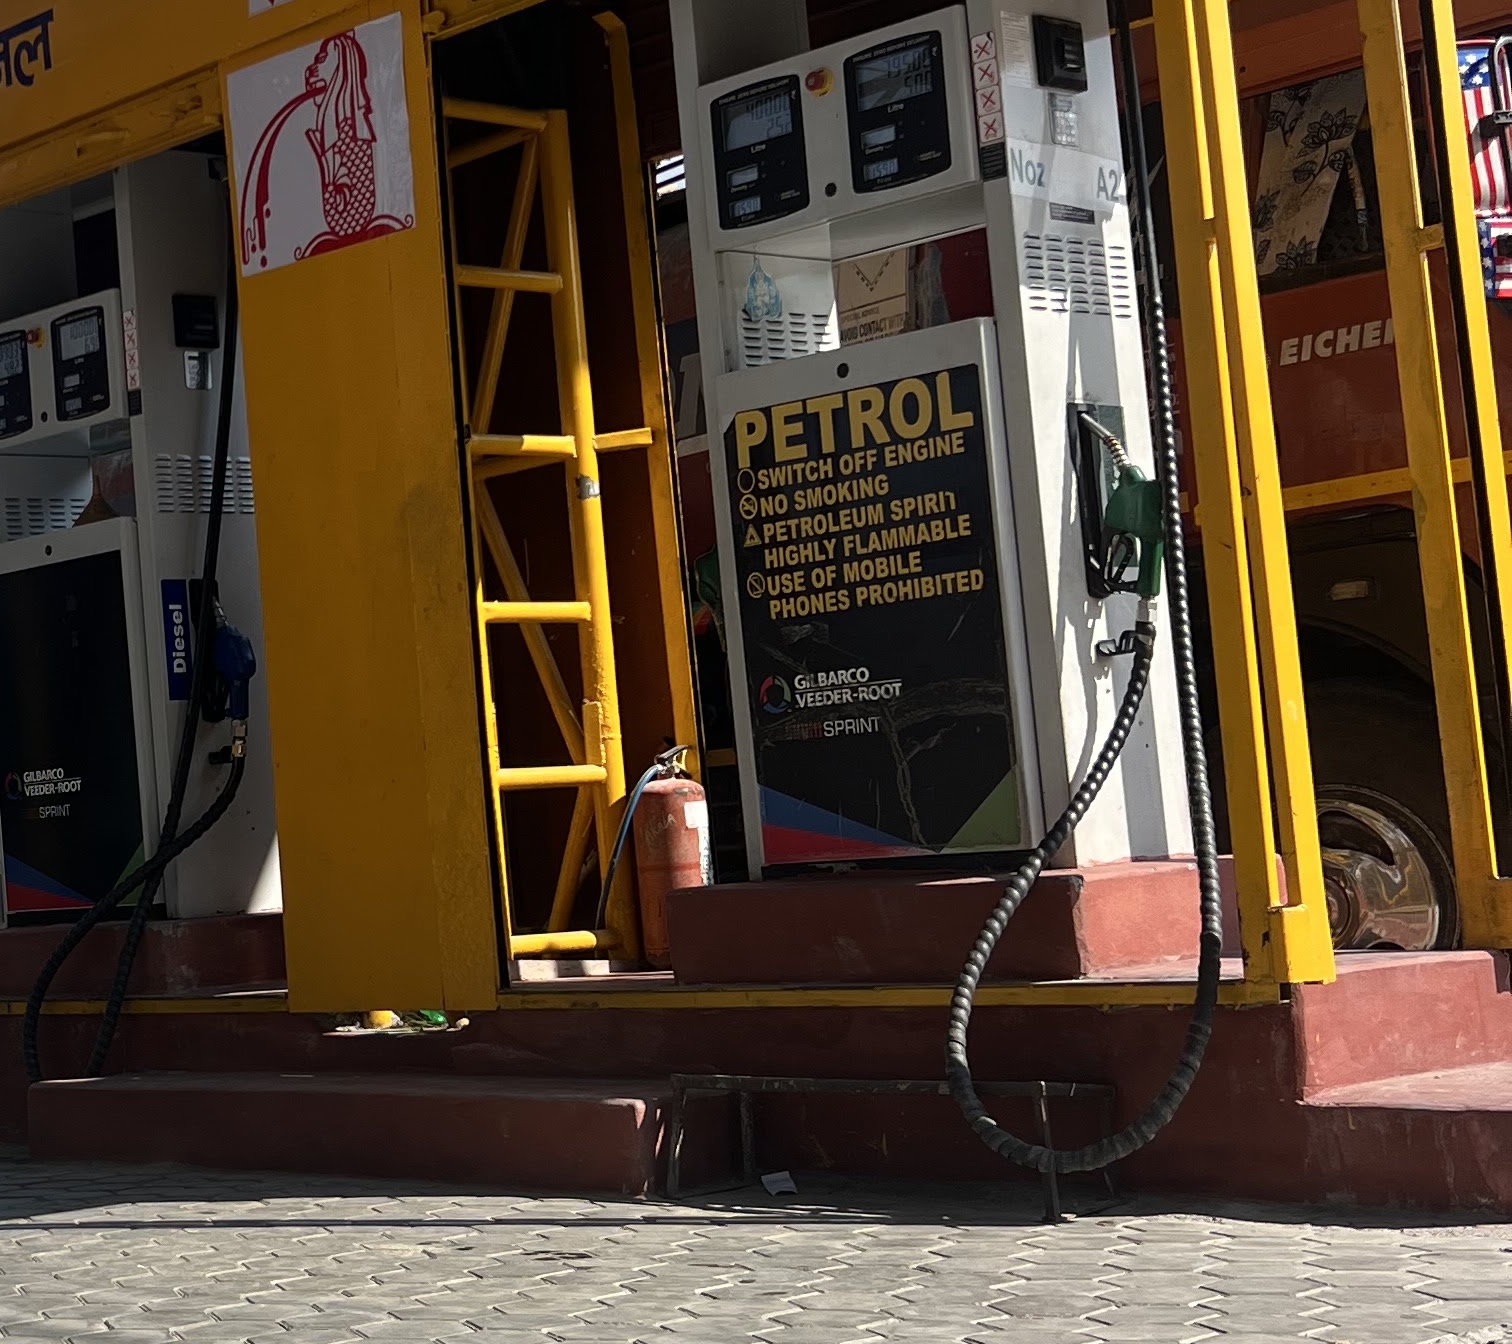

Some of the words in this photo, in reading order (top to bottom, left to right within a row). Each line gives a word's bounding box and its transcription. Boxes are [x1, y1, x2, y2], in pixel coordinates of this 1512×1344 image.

[1097, 167, 1120, 201] A2
[734, 371, 975, 469] PETROL
[757, 457, 834, 490] SWITCH
[839, 449, 878, 476] OFF
[884, 431, 966, 468] ENGINE
[760, 493, 788, 518] NO
[794, 473, 890, 511] SMOKING
[763, 503, 885, 545] PETROLEUM
[890, 491, 957, 521] SPIRIT
[764, 538, 837, 570] HIGHLY
[843, 513, 972, 557] FLAMMABLE
[766, 573, 806, 597] USE
[811, 565, 837, 589] OF
[843, 551, 923, 584] MOBILE
[769, 589, 851, 620] PHONES
[856, 568, 985, 607] PROHIBITED
[168, 604, 187, 674] Diesel
[793, 667, 870, 690] GILBARCO
[794, 682, 903, 709] VEEDER-ROOT
[823, 716, 881, 737] SPRINT
[23, 767, 64, 783] GILBARCO
[24, 779, 82, 797] VEEDER-ROOT
[39, 804, 71, 819] SPRINT
